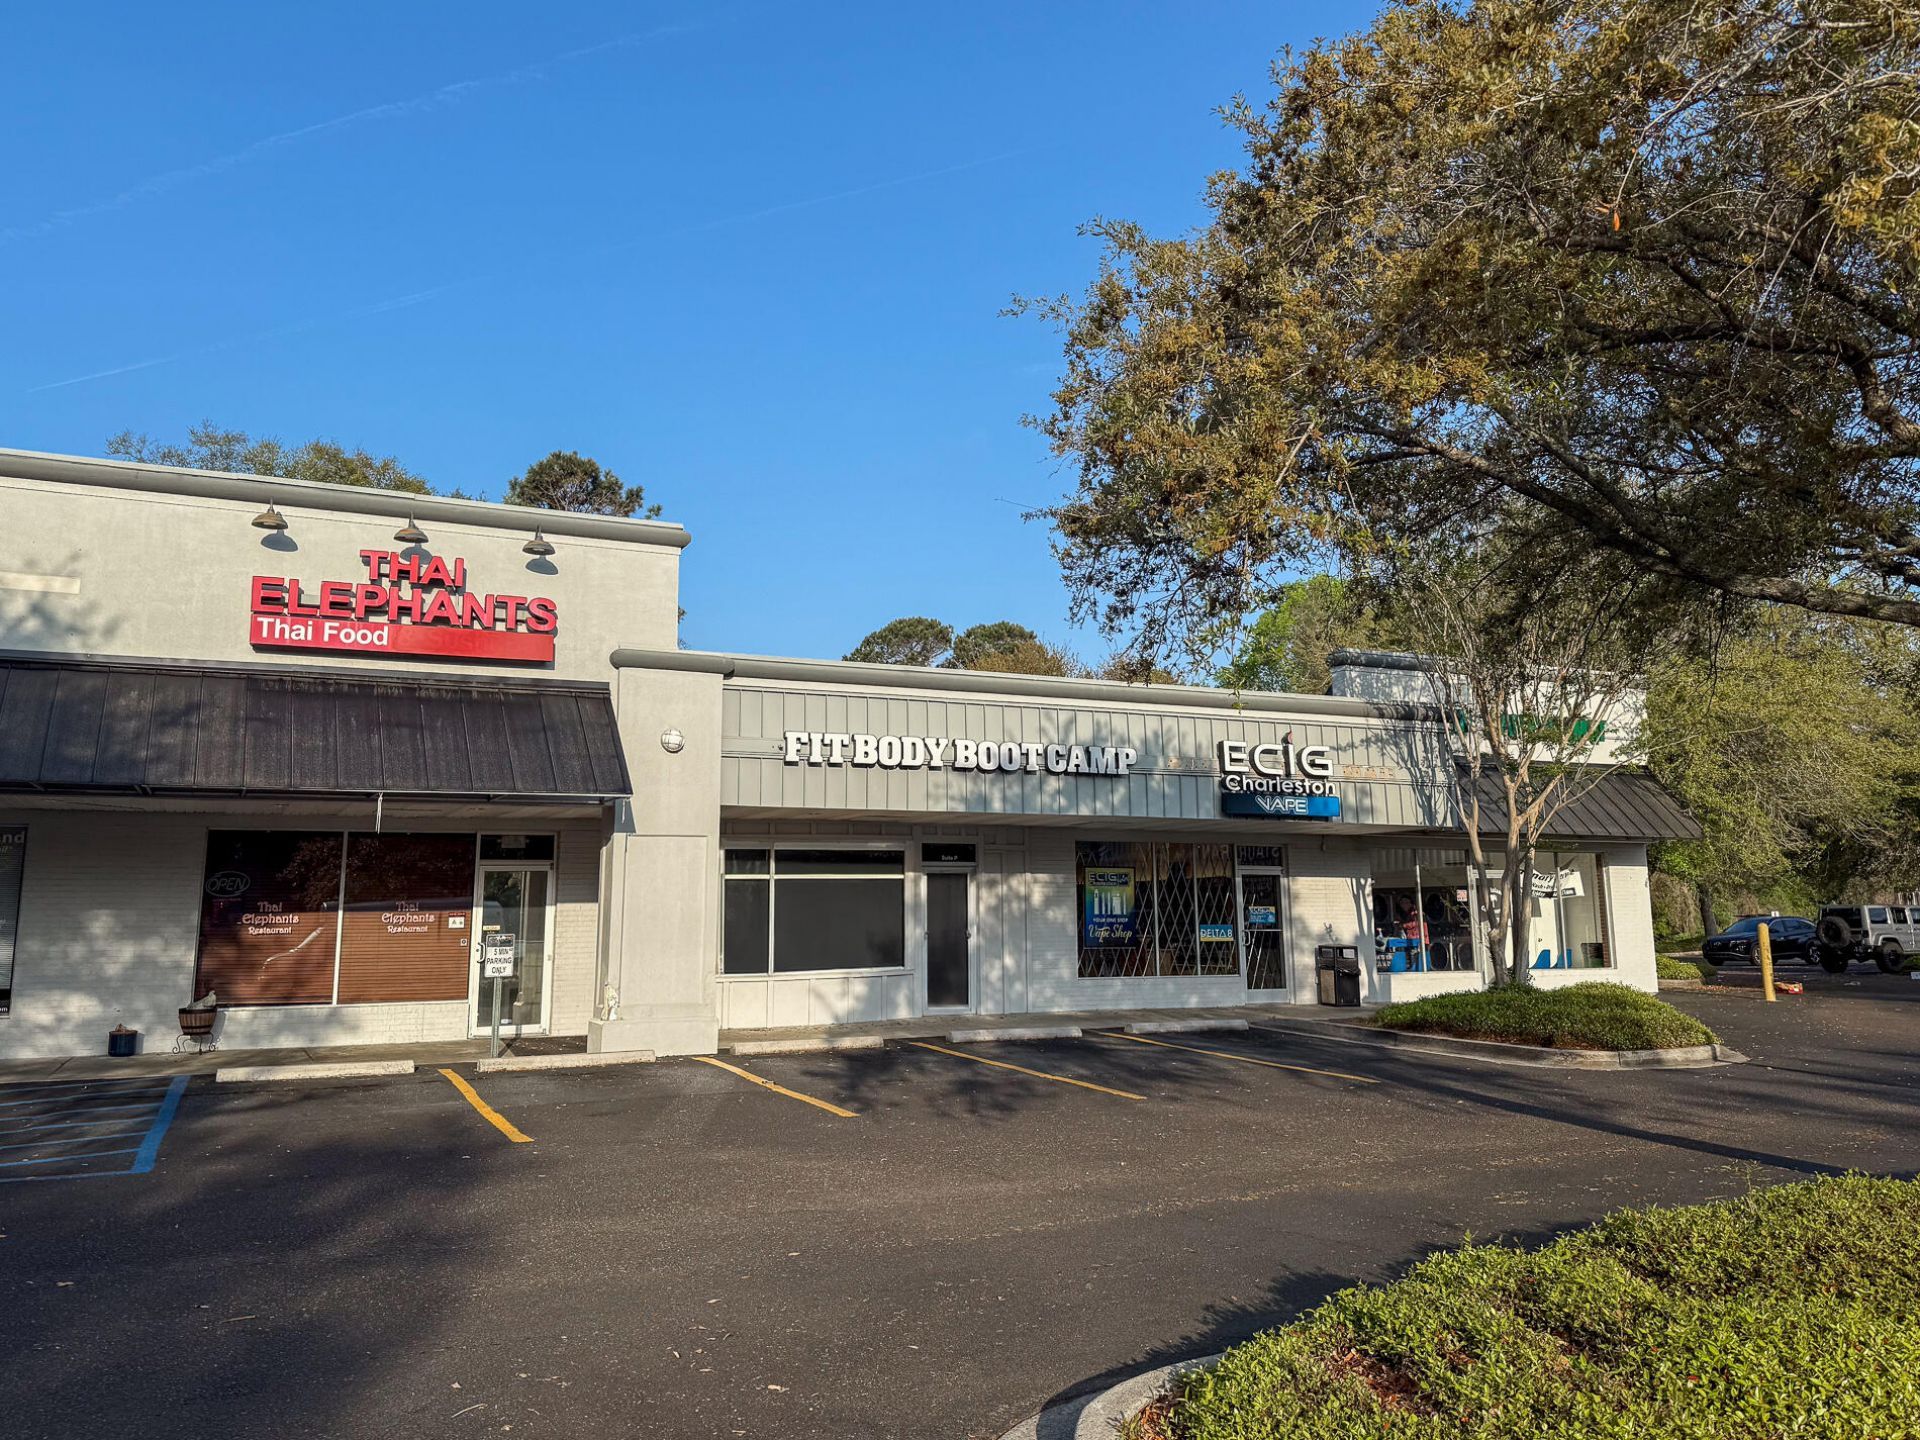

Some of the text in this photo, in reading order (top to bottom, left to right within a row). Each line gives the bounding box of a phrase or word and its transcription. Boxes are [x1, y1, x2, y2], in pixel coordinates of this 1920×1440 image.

[360, 550, 465, 587] THAI
[250, 575, 557, 631] ELEPHANTS
[257, 617, 313, 641] Thai
[323, 622, 389, 646] Food
[785, 731, 1137, 776] FIT BODY BOOT CAMP
[1224, 774, 1337, 796] Charleston
[1255, 795, 1309, 815] VAPE
[0, 831, 25, 844] nd
[208, 878, 245, 891] OPEN
[257, 901, 283, 912] Thai
[396, 901, 420, 911] Thai
[241, 912, 300, 926] Elephants
[381, 912, 436, 925] Elephants
[248, 926, 292, 935] Restaurant
[387, 925, 428, 934] Restaurant
[1088, 923, 1133, 944] Vape Shop
[486, 956, 513, 965] PARKING
[491, 966, 507, 974] ONLY
